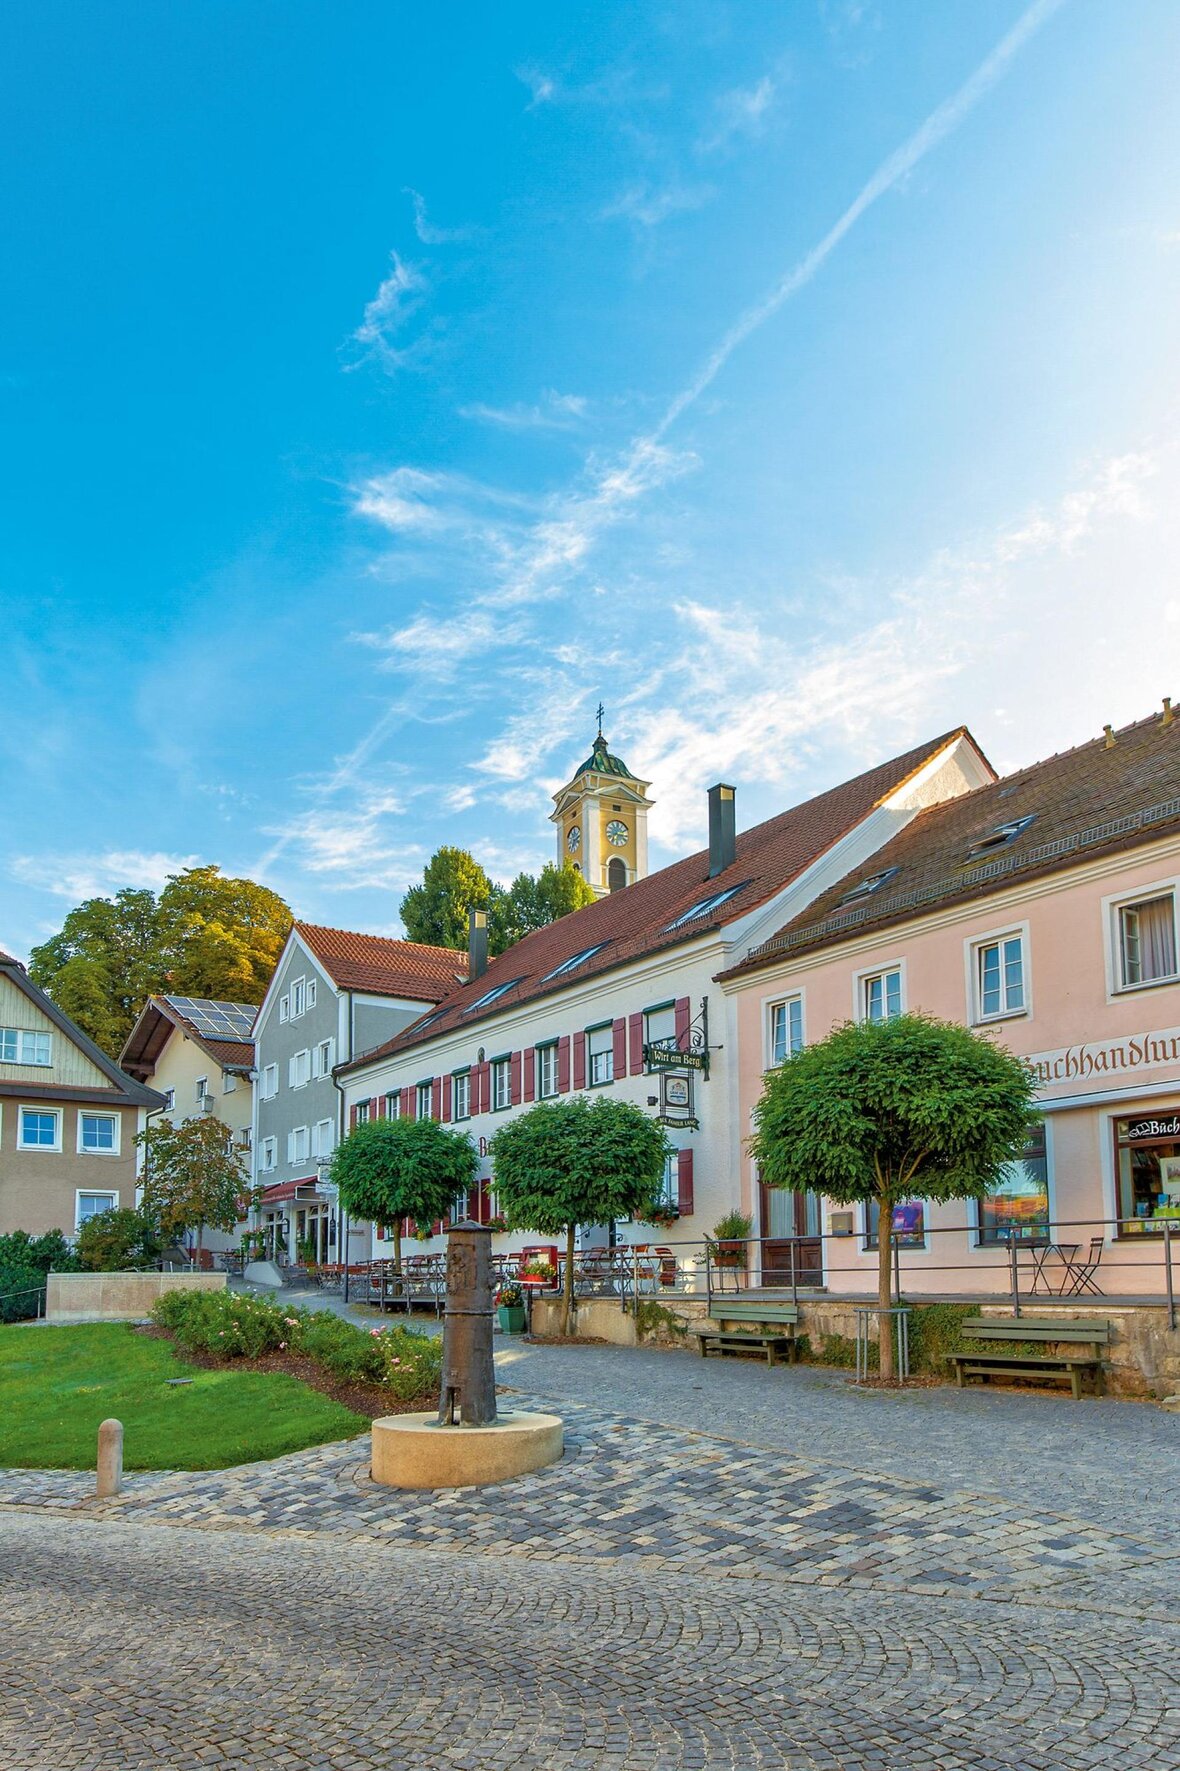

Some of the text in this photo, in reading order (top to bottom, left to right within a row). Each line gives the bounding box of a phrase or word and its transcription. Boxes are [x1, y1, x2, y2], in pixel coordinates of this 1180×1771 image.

[654, 1050, 701, 1067] Wirt am Berg
